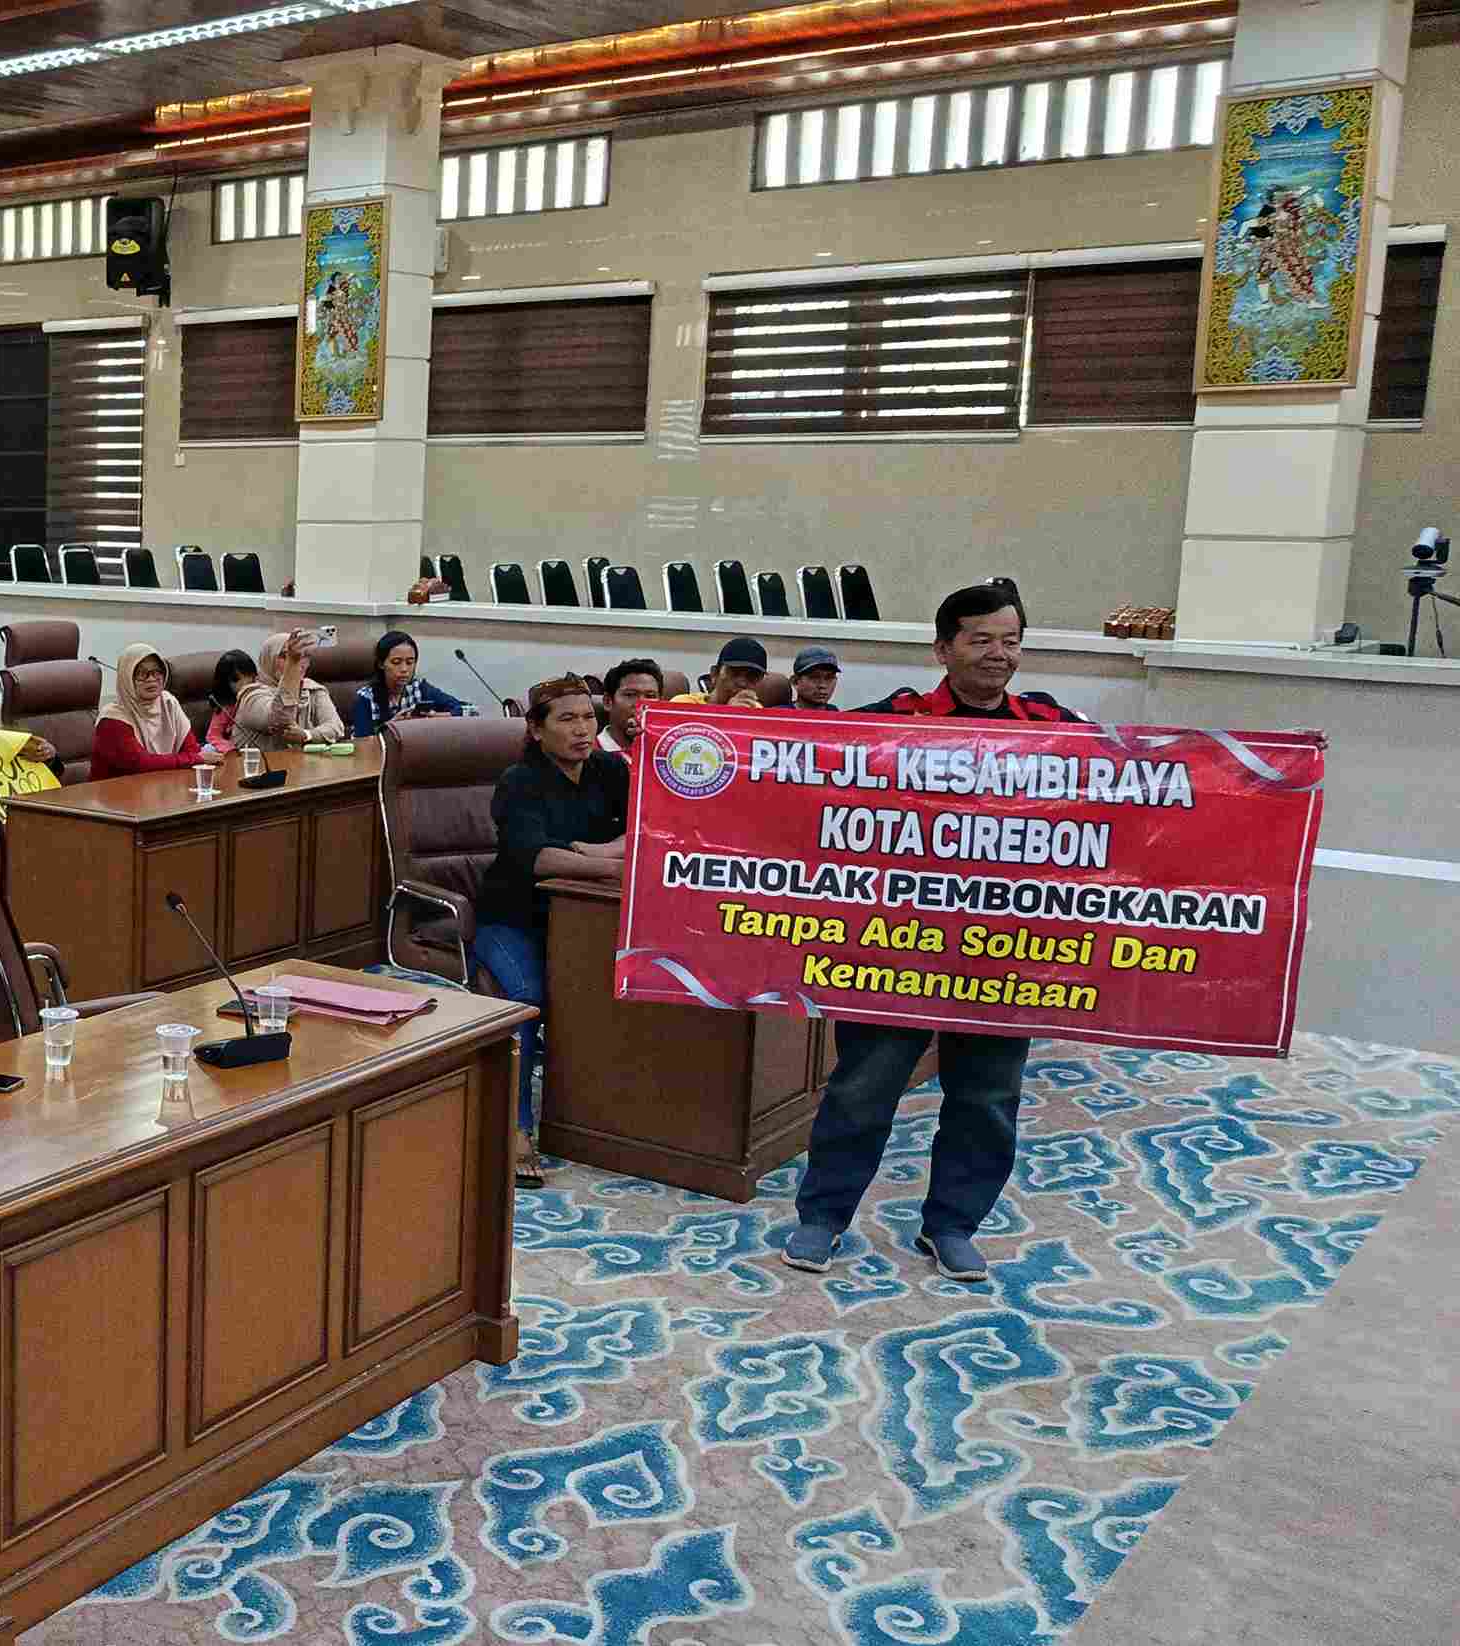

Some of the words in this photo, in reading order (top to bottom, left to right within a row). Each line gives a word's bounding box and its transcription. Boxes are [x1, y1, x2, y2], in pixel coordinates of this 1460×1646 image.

[749, 738, 825, 786] PKL
[830, 744, 888, 790] JL.
[895, 746, 1080, 801] KESAMBI
[1087, 756, 1196, 809] RAYA
[819, 804, 926, 857] KOTA
[931, 811, 1111, 869] CIREBON
[664, 852, 875, 902] MENOLAK
[886, 871, 1263, 932] PEMBONGKARAN
[717, 902, 847, 946] Tanpa
[859, 916, 946, 954] Ada
[960, 925, 1096, 965] Solusi
[1110, 936, 1198, 973] Dan
[802, 953, 1099, 1012] Kemanusiaan
